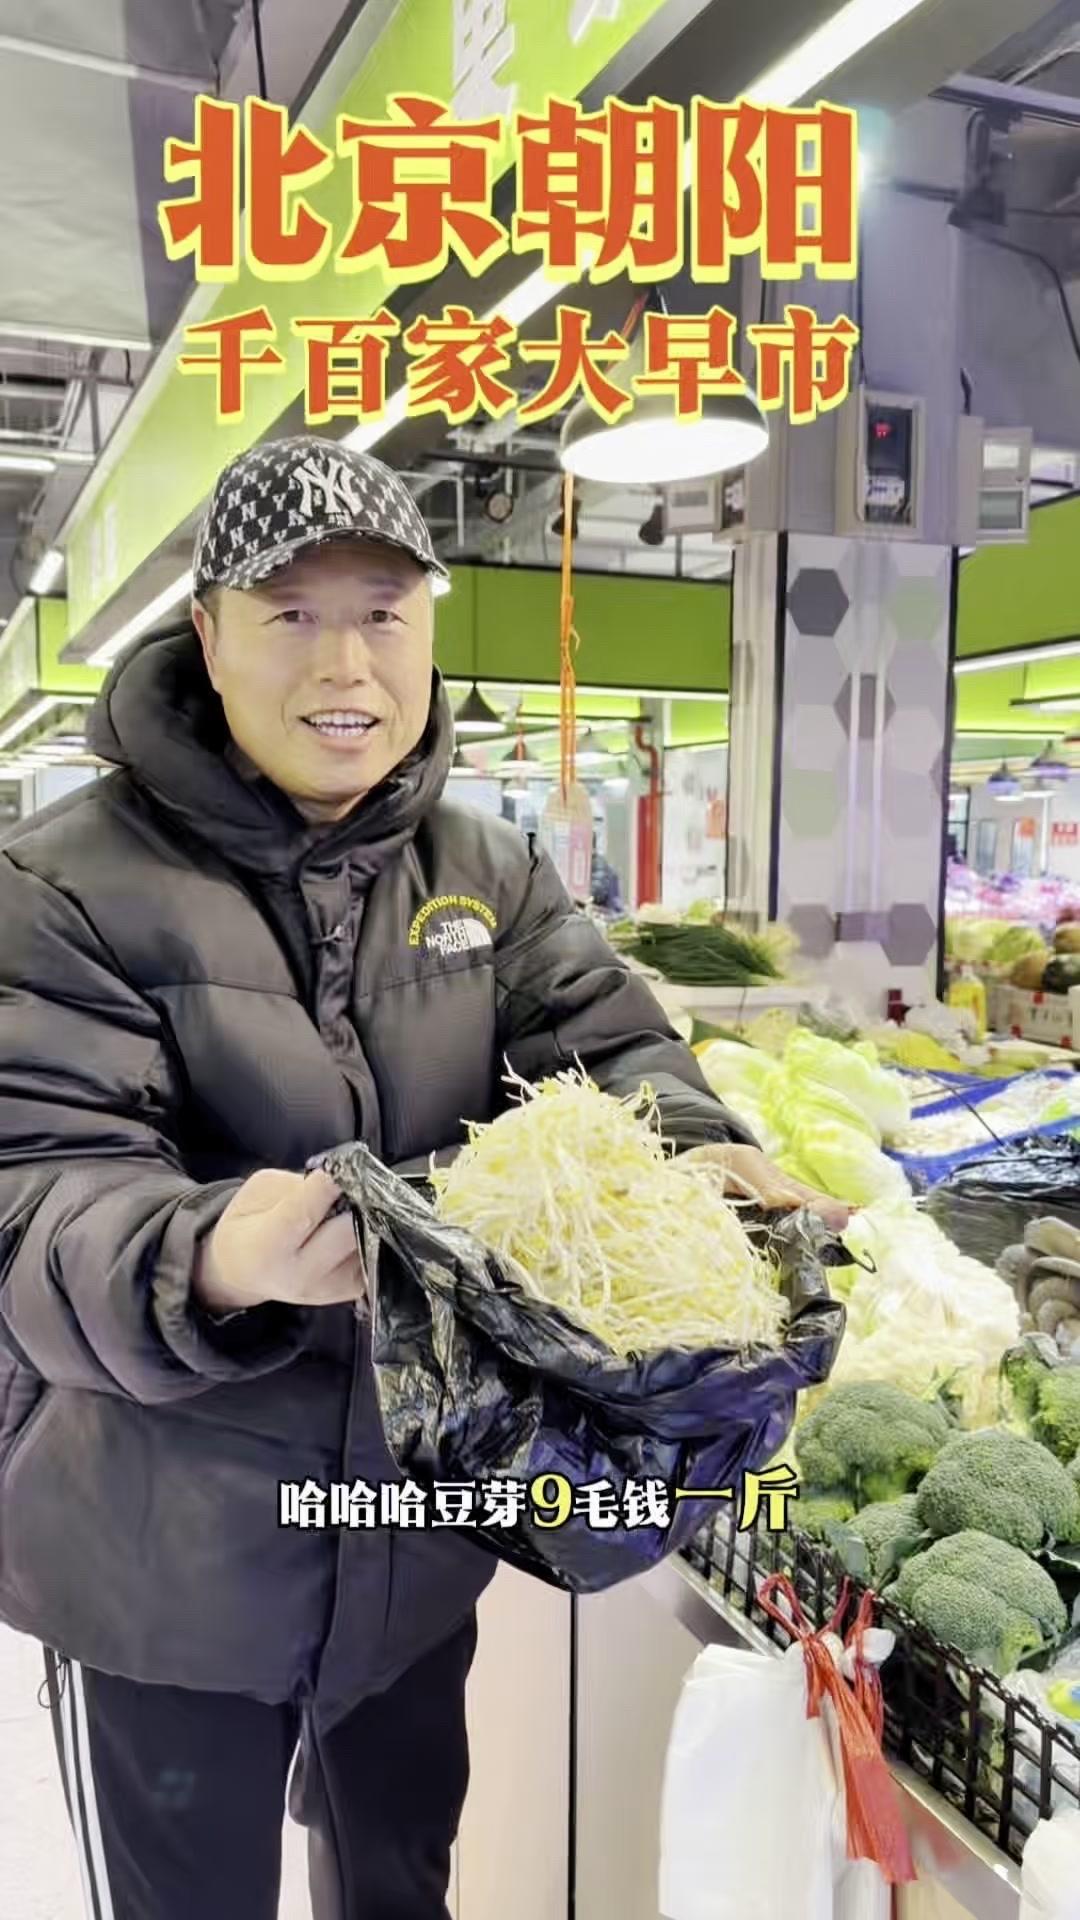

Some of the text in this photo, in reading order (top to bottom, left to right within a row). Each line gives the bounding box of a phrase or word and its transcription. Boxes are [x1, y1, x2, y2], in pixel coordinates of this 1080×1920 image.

[292, 456, 363, 518] NY
[408, 895, 497, 946] EXPEDITION SYSTEM
[440, 919, 465, 935] THE
[425, 927, 470, 949] NORTH
[440, 941, 471, 957] FACE
